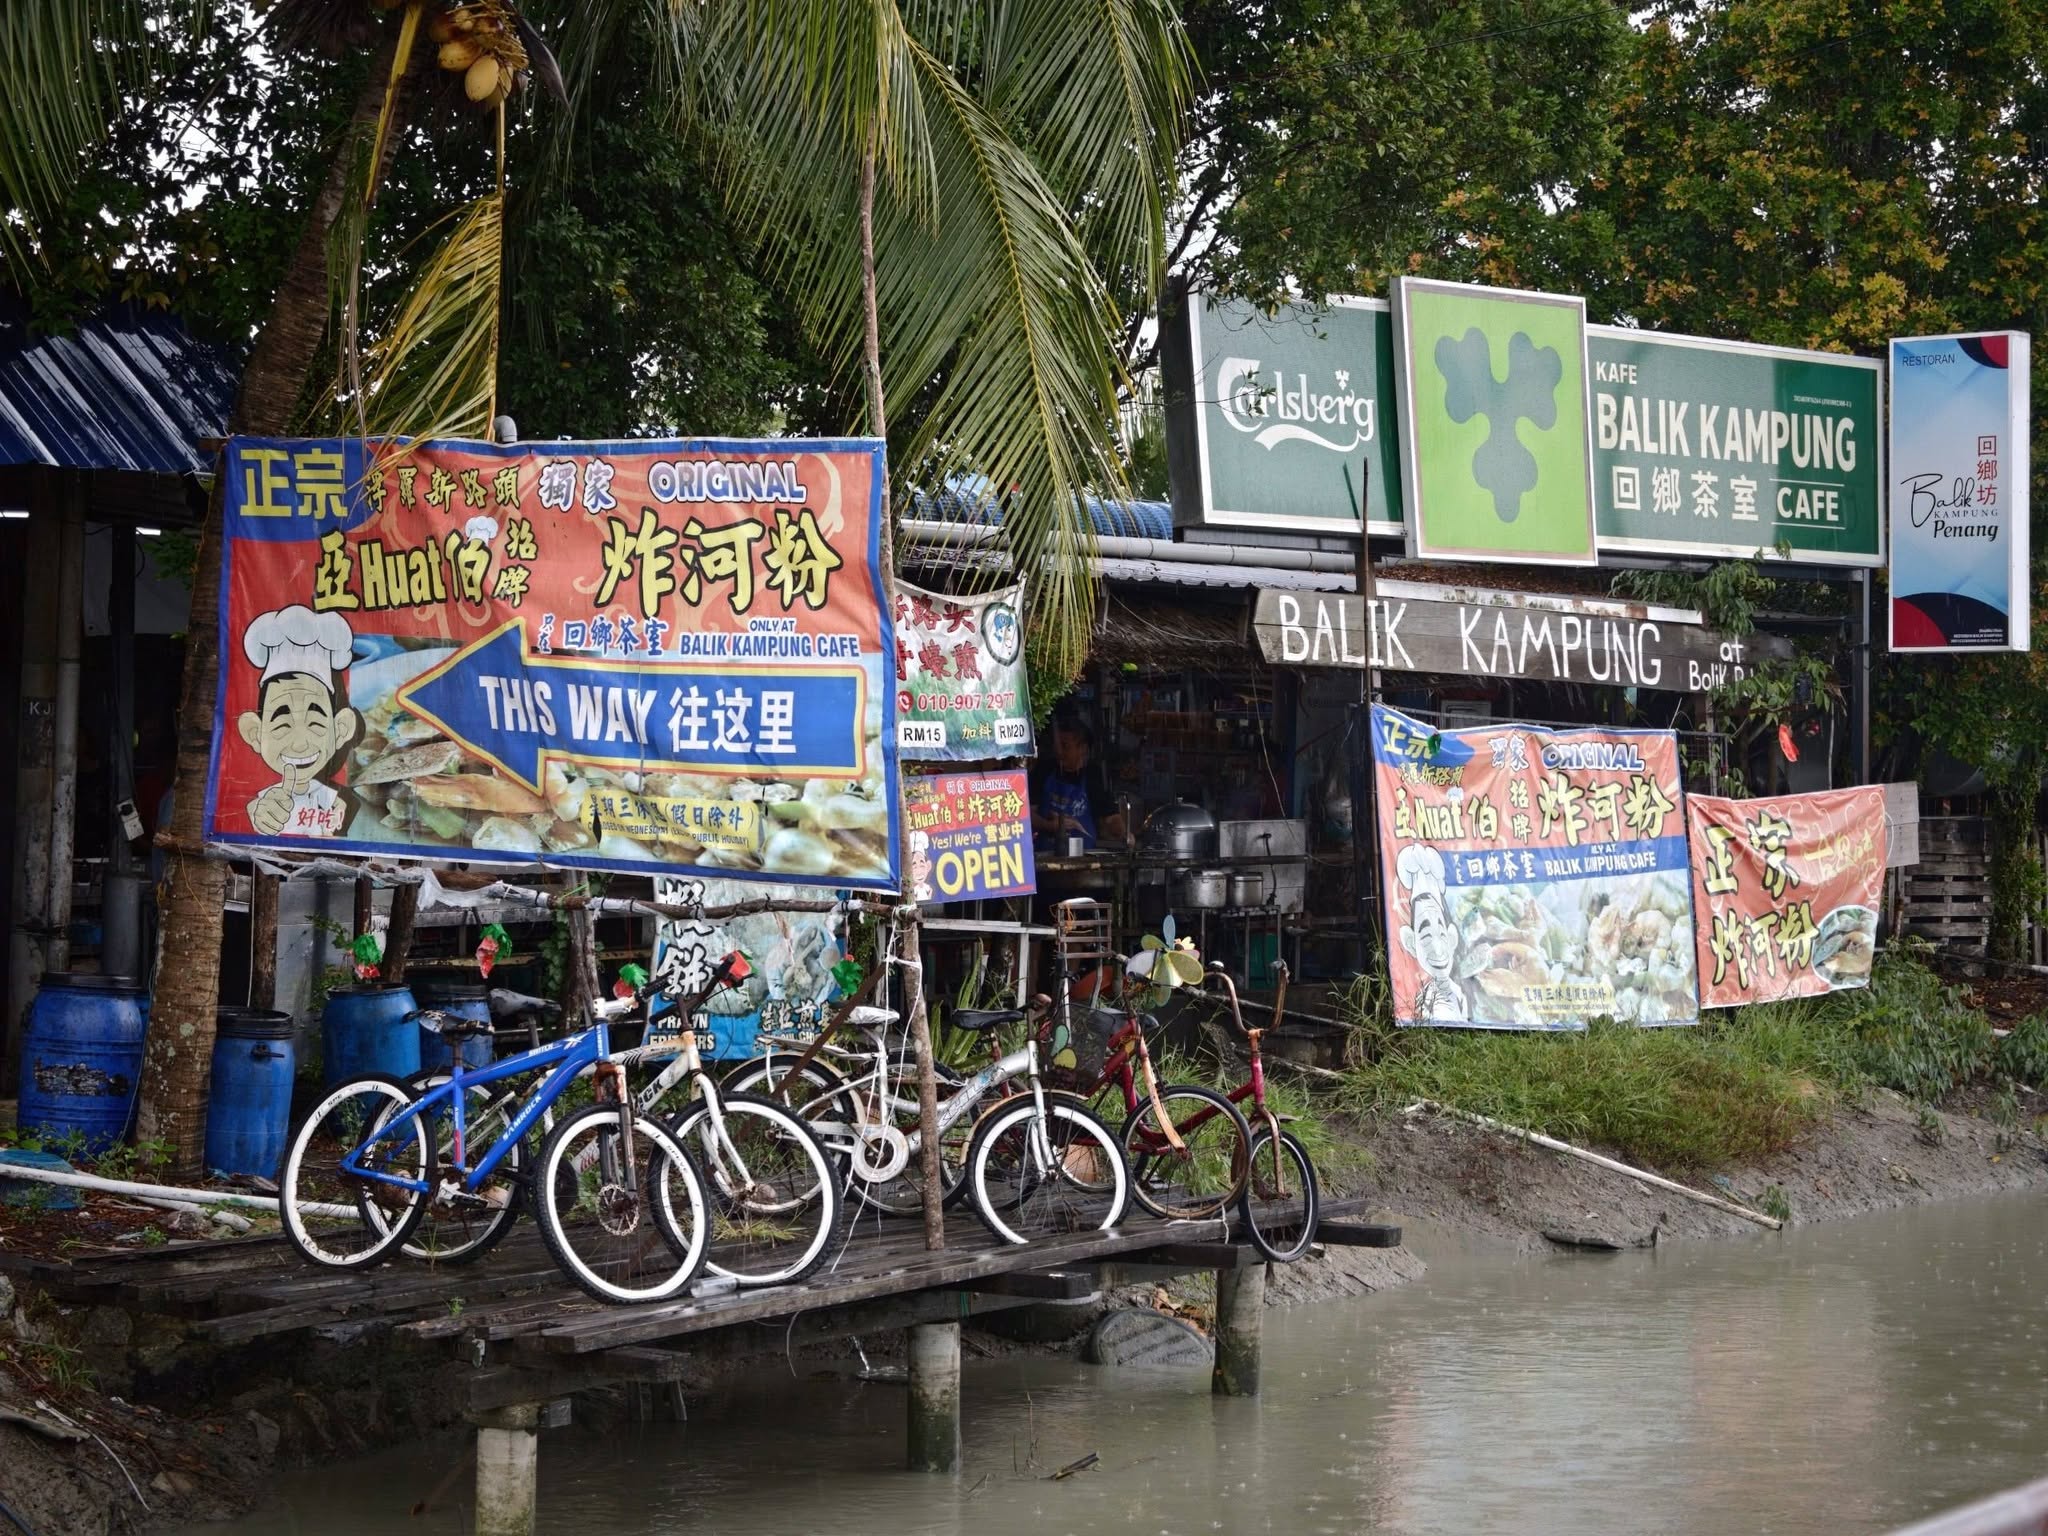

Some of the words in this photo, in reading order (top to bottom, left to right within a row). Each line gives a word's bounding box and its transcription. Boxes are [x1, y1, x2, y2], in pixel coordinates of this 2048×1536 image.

[1596, 361, 1637, 384] KAFE
[1902, 354, 1955, 367] RESTORAN
[1217, 357, 1374, 446] Carlsberg
[1597, 392, 1690, 457] BALIK
[1700, 403, 1856, 472] KAMPUNG
[239, 448, 348, 519] 正宗
[648, 460, 807, 503] ORIGINAL
[1976, 435, 1998, 506] 回鄉坊
[539, 458, 617, 514] 獨家
[1612, 465, 1759, 521] 回鄉茶室
[1900, 473, 1975, 528] Balik
[1777, 487, 1839, 521] CAFE
[1934, 509, 1998, 519] KAMPUNG
[1933, 519, 1999, 542] Penang
[594, 507, 843, 618] 炸河粉
[563, 615, 668, 656] 回鄉茶室
[749, 619, 778, 631] ONLY
[781, 619, 795, 631] AT
[1279, 594, 1415, 669] BALIK
[1459, 606, 1662, 686] KAMPUNG
[680, 635, 727, 656] BALIK
[732, 636, 811, 657] KAMPUNG
[817, 637, 860, 657] CAFE
[1720, 635, 1744, 663] at
[479, 676, 557, 736] THIS
[566, 684, 658, 744] WAY
[668, 685, 797, 753] 往这里
[918, 693, 981, 711] 010-907
[903, 727, 941, 742] RM15
[1000, 724, 1025, 739] RM20
[1541, 742, 1645, 771] ORIGINAL
[970, 779, 1011, 792] ORIGINAL
[968, 791, 1023, 822] 炸河粉
[693, 833, 719, 844] PUBLIC
[931, 835, 952, 850] Yes!
[954, 831, 981, 847] We're
[1605, 843, 1617, 853] AT
[936, 843, 1024, 896] OPEN
[1545, 858, 1582, 876] BALIK
[1628, 851, 1656, 870] CAFE
[1711, 899, 1820, 989] 炸河粉
